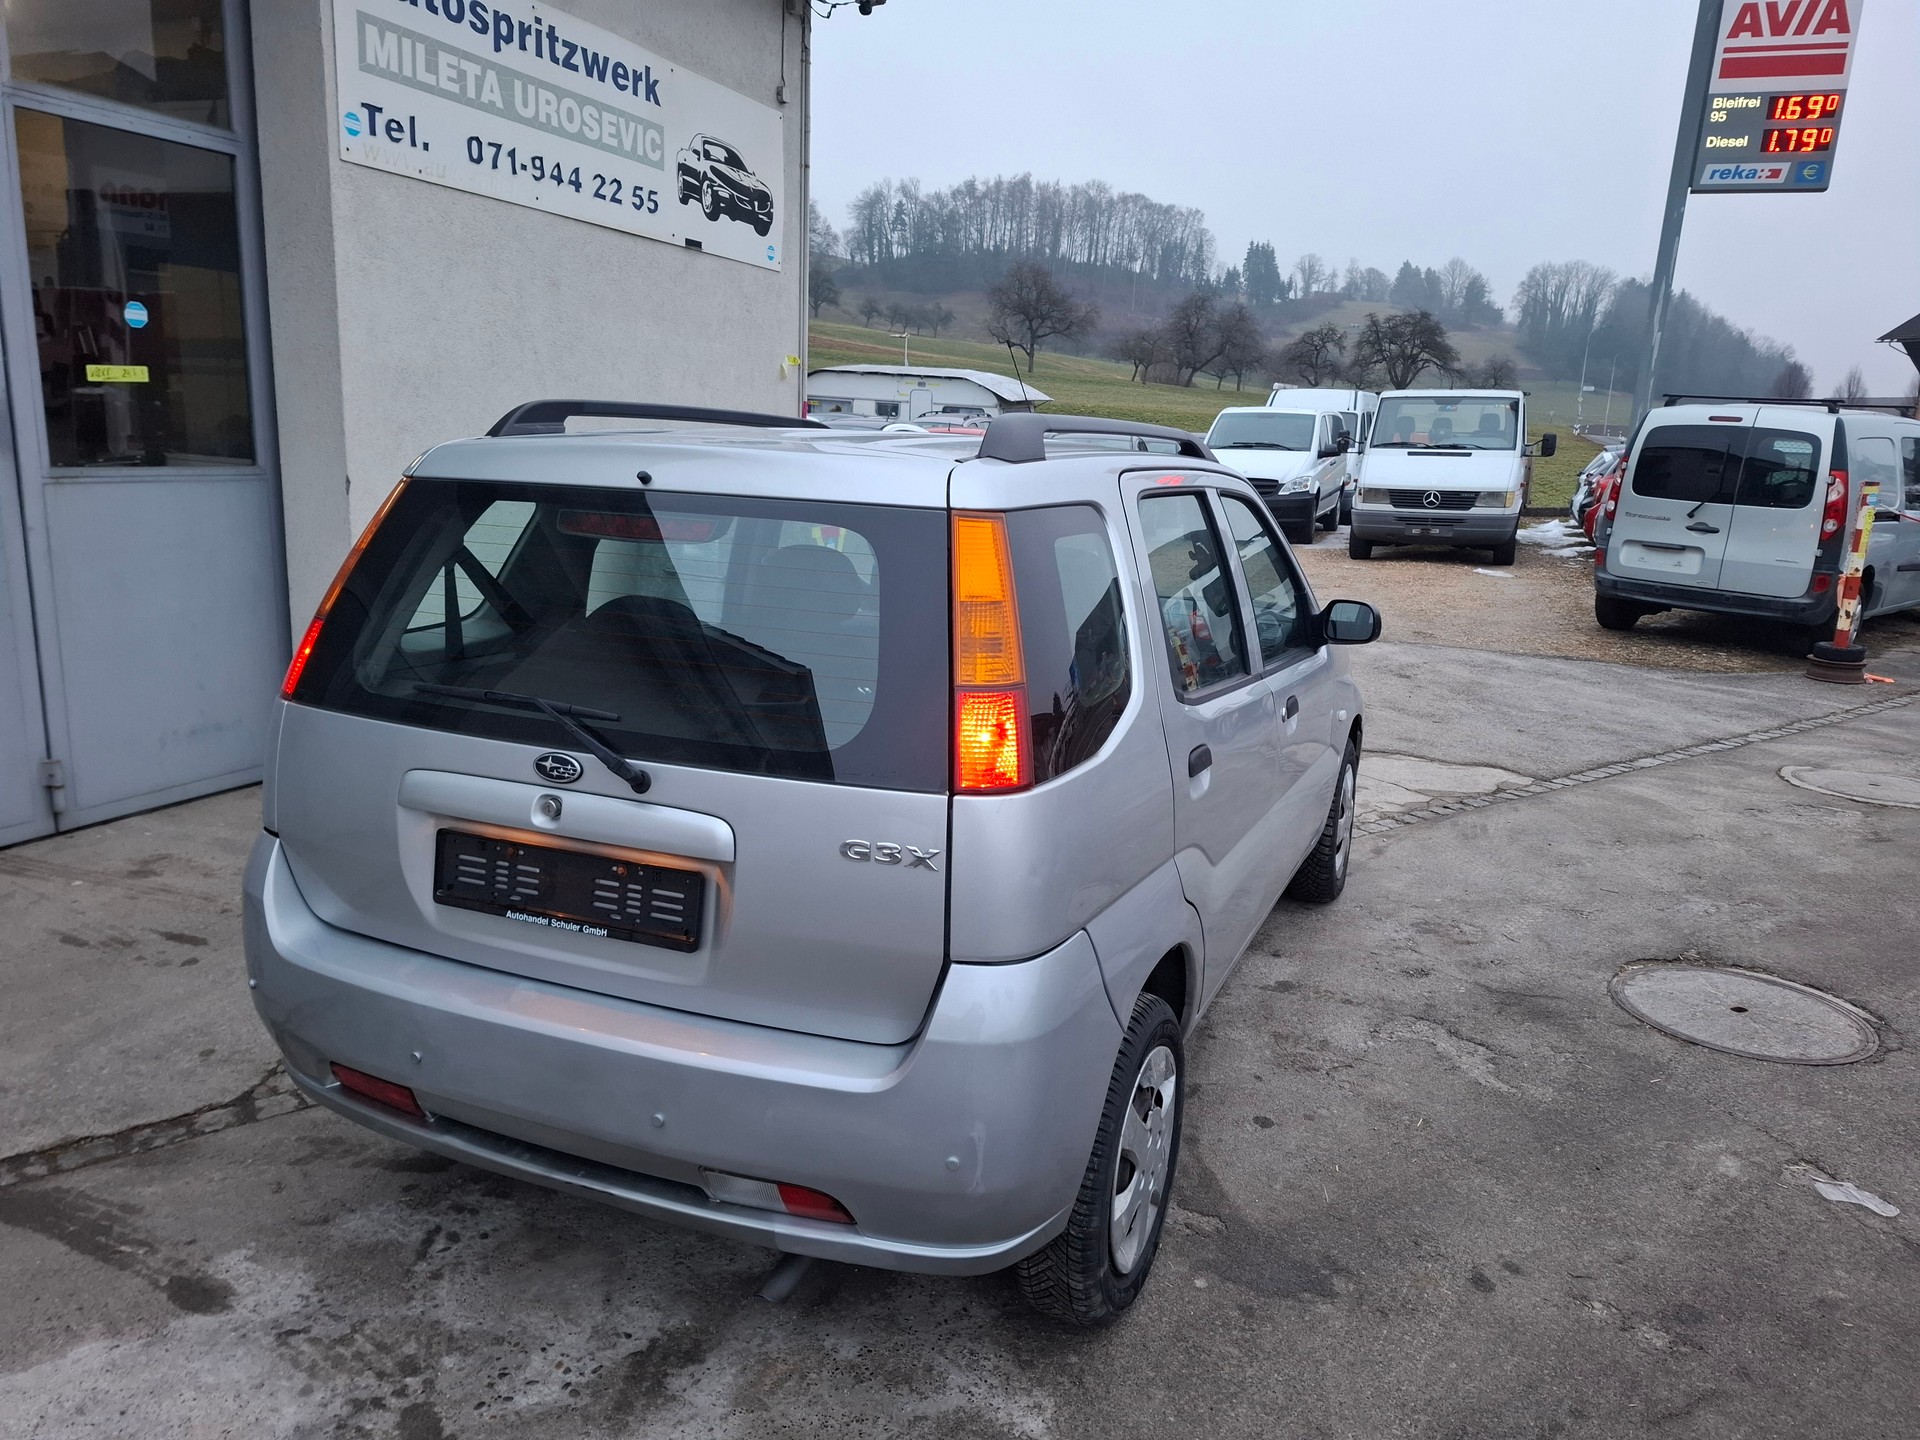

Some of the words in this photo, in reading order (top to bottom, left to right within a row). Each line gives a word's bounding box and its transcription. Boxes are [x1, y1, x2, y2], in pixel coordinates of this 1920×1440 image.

[1726, 0, 1851, 39] AVIA
[399, 0, 661, 107] ospritzwerk
[365, 23, 504, 110] MILETA
[513, 79, 664, 162] UROSEVIC
[1712, 96, 1761, 109] Bleifrei
[1710, 111, 1727, 122] 95
[1705, 135, 1749, 148] Diesel
[360, 102, 430, 152] Tel.
[466, 135, 582, 194] 071-944
[593, 173, 623, 205] 22
[632, 185, 659, 215] 55
[839, 839, 941, 872] G3X
[505, 909, 549, 926] Autohandel
[550, 918, 581, 932] Schuler
[582, 925, 608, 937] GmbH
